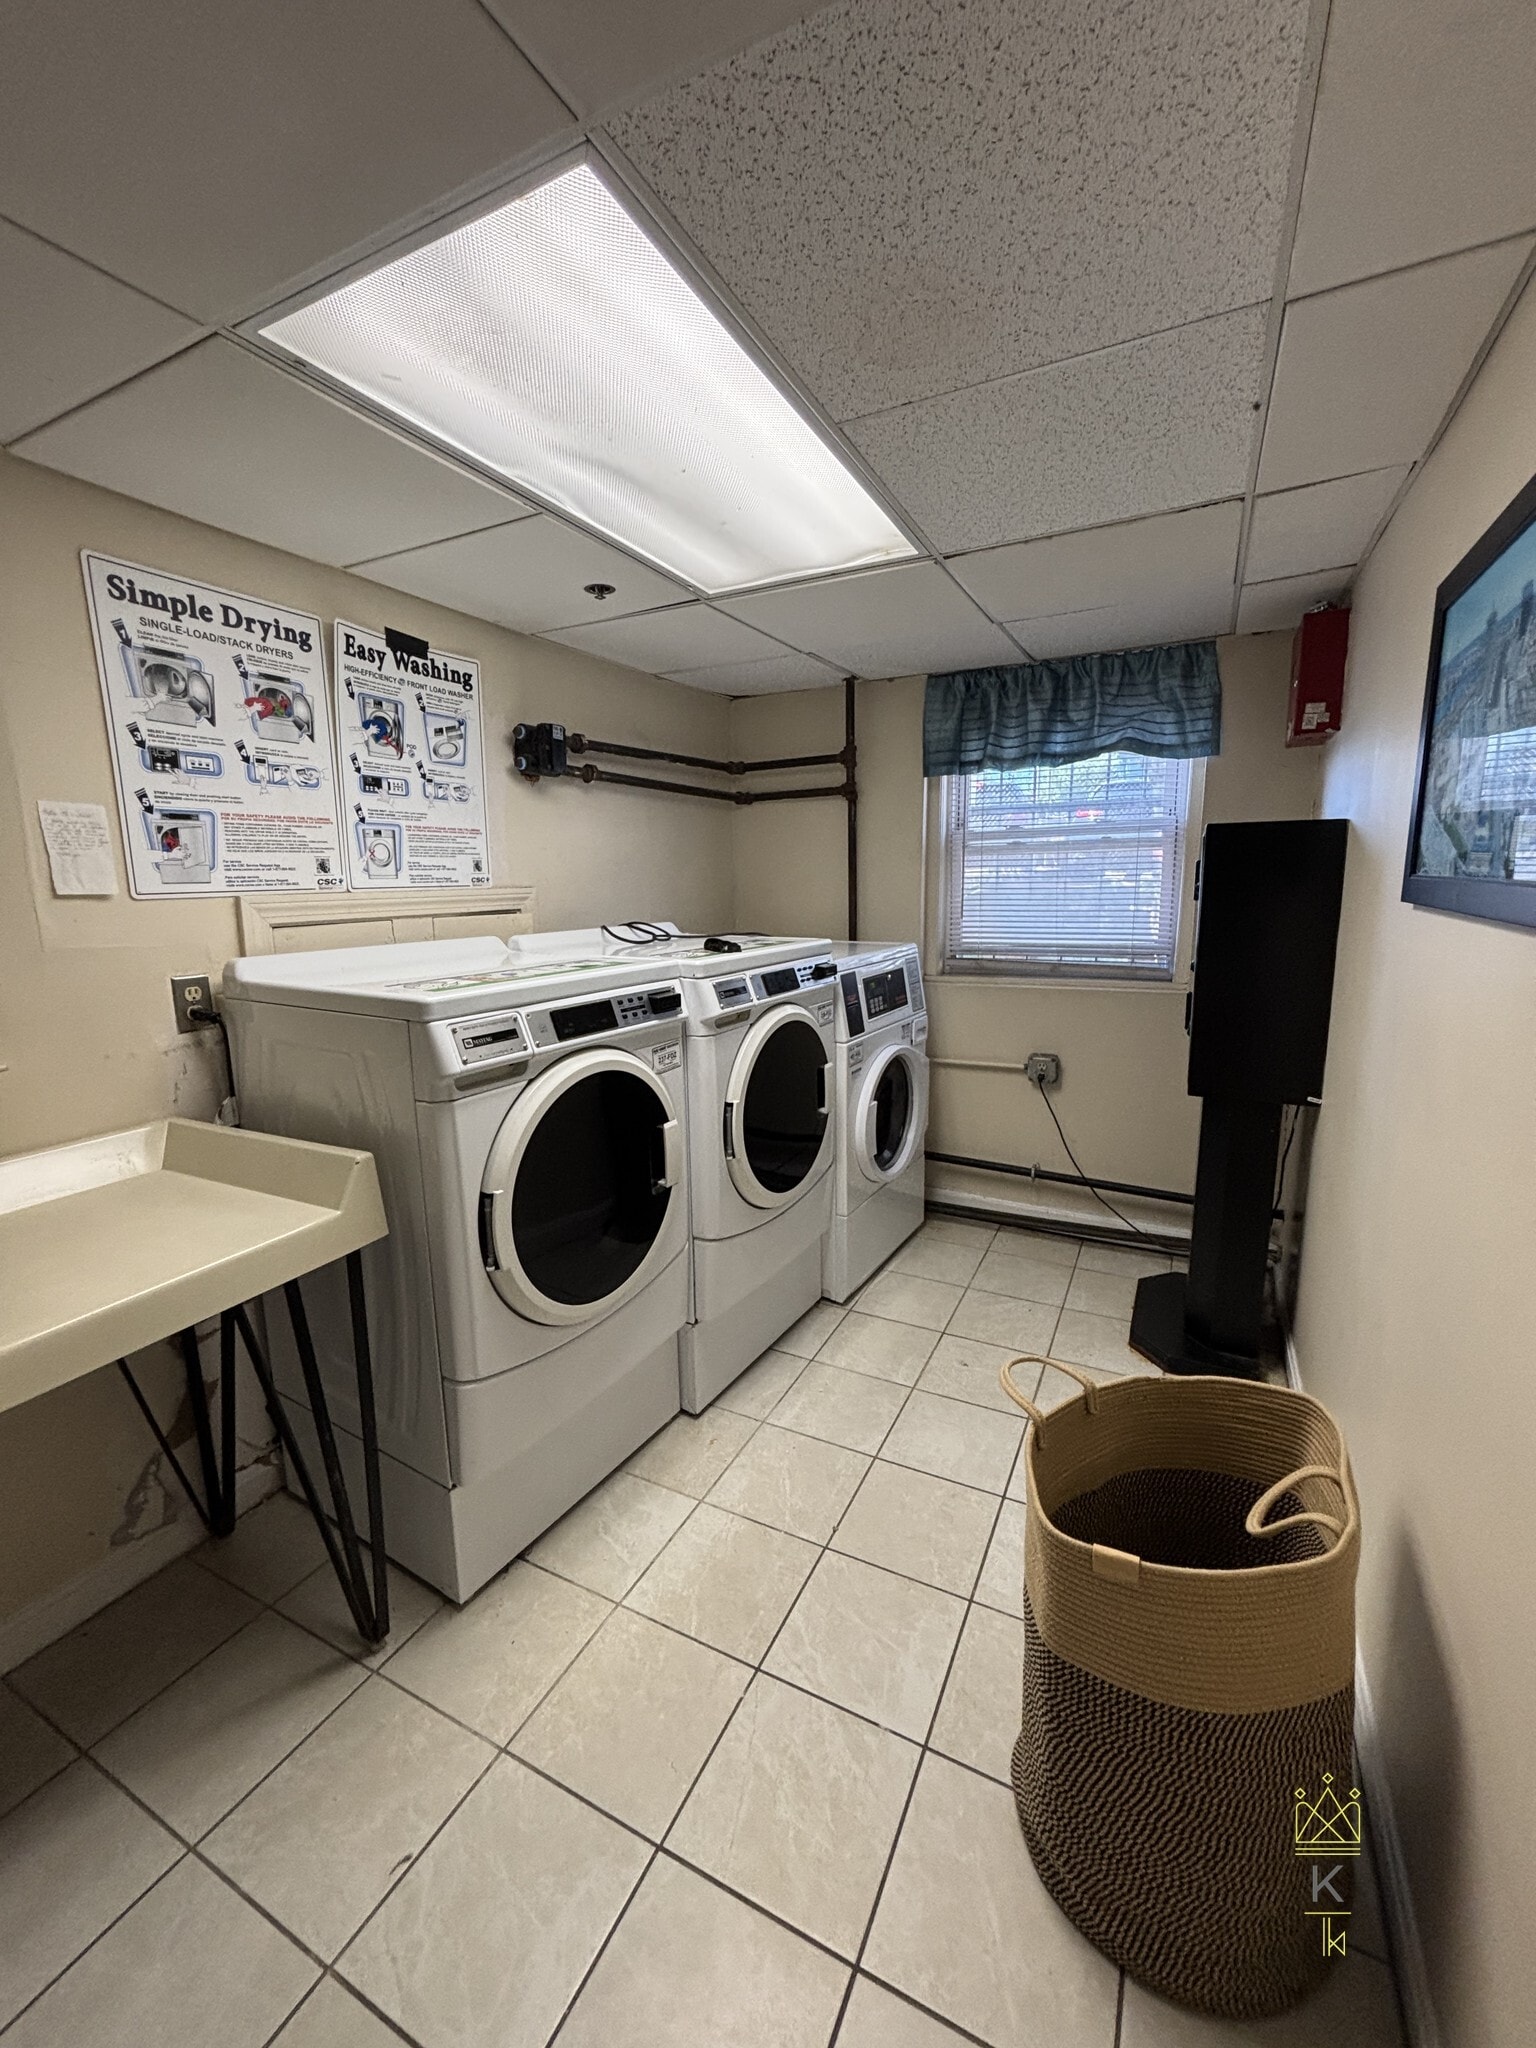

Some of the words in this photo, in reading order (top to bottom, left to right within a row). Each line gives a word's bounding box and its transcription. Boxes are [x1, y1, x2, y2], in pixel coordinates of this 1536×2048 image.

[106, 574, 214, 622] Simple
[220, 603, 313, 653] Drying
[139, 616, 253, 651] SINGLE-LOAD/STACK
[255, 643, 294, 660] DRYERS
[344, 633, 386, 672] Easy
[391, 648, 473, 692] Washing
[344, 664, 397, 684] HIGH-EFFICIENCY
[407, 680, 428, 691] FRONT
[429, 685, 447, 695] LOAD
[447, 689, 474, 700] WASHER
[142, 798, 149, 806] 5
[317, 878, 337, 886] CSC
